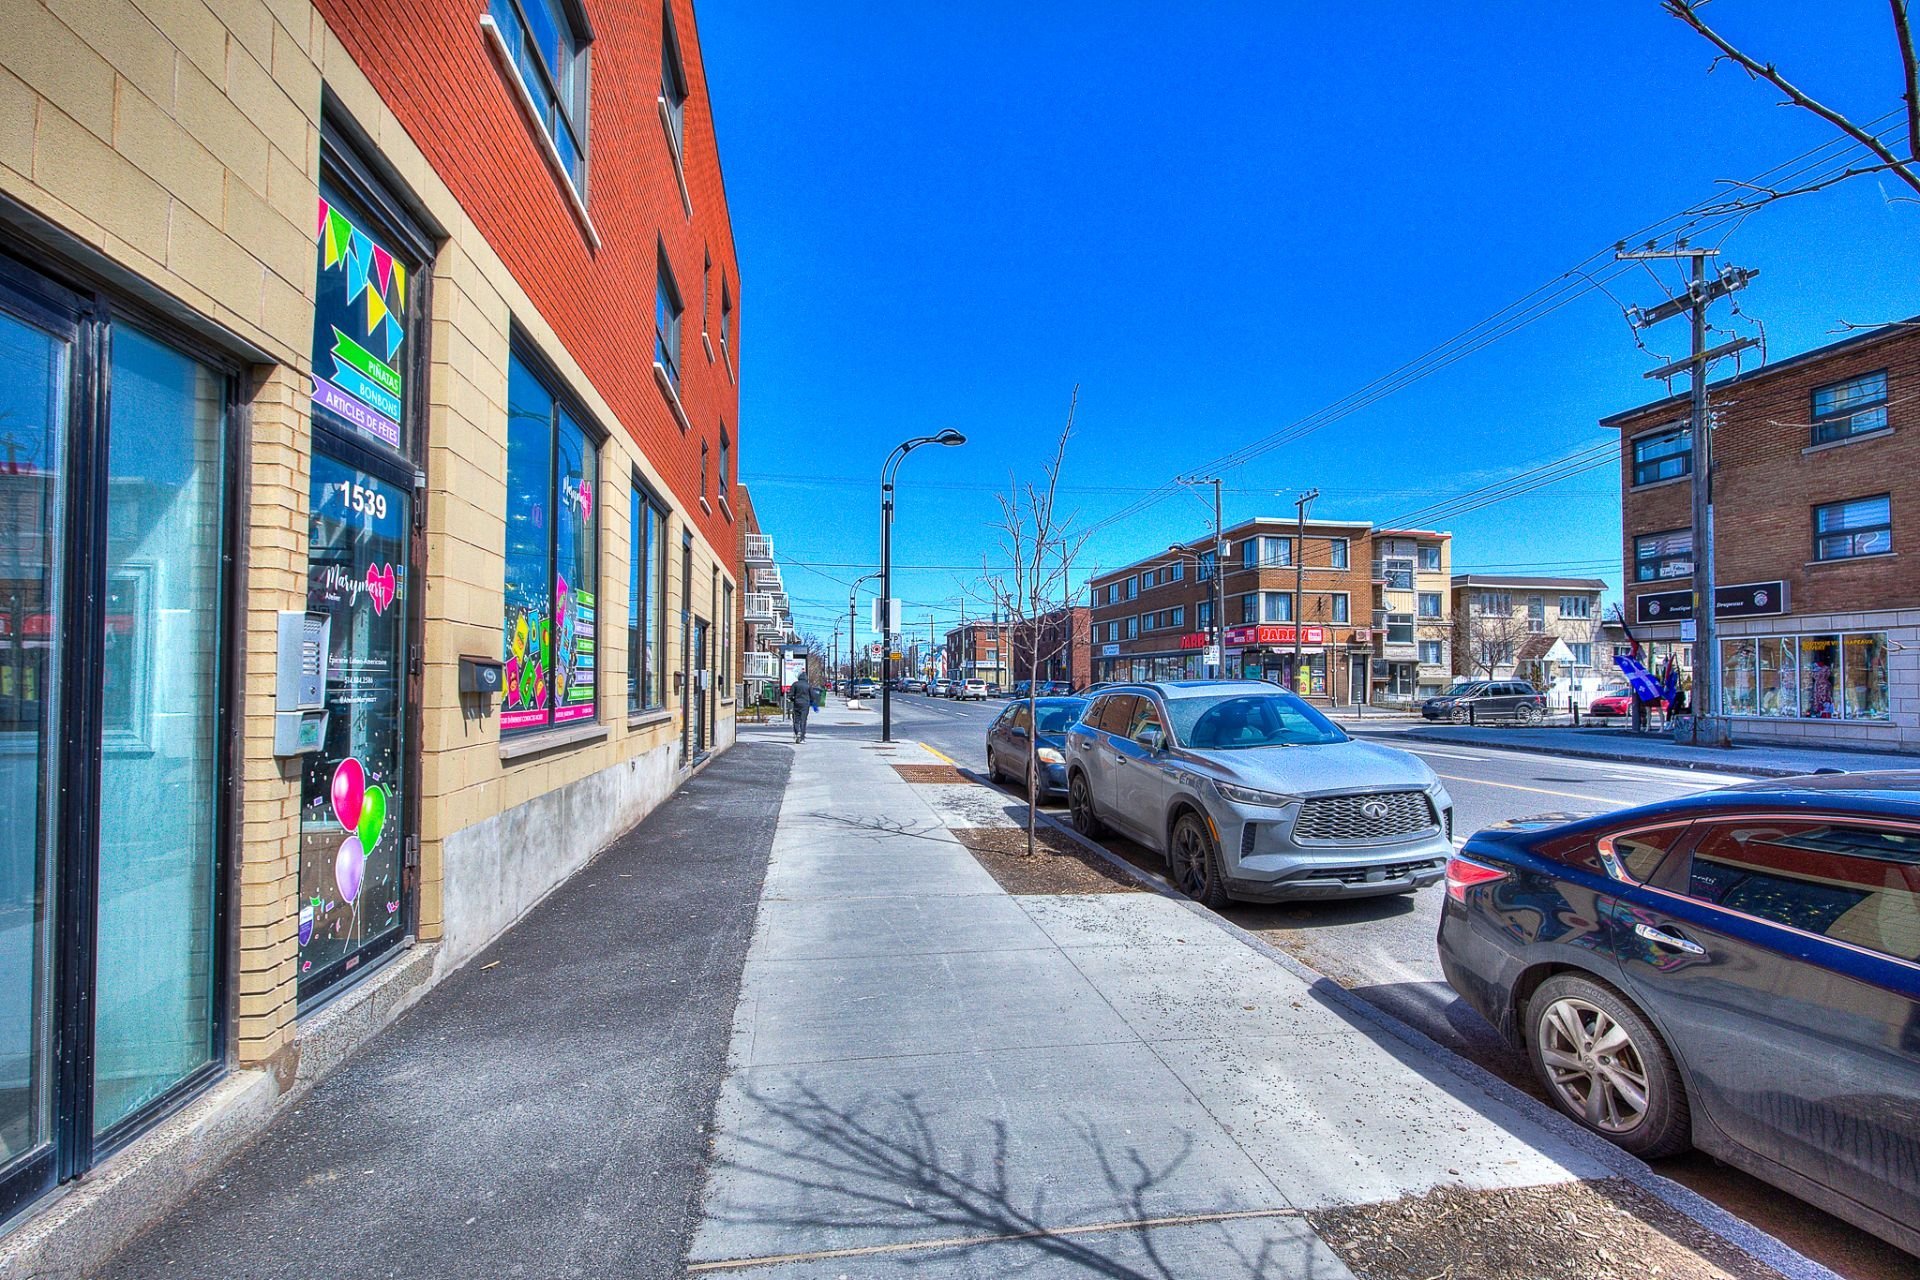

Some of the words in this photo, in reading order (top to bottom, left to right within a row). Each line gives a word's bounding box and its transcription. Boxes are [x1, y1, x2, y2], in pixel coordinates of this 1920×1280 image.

[368, 360, 399, 391] PIÑATAS
[326, 391, 365, 423] ARTICLES
[366, 415, 378, 432] DE
[378, 420, 397, 442] FÊTES
[360, 382, 398, 417] BONBONS
[340, 480, 386, 520] 1539
[1181, 632, 1209, 649] JARR
